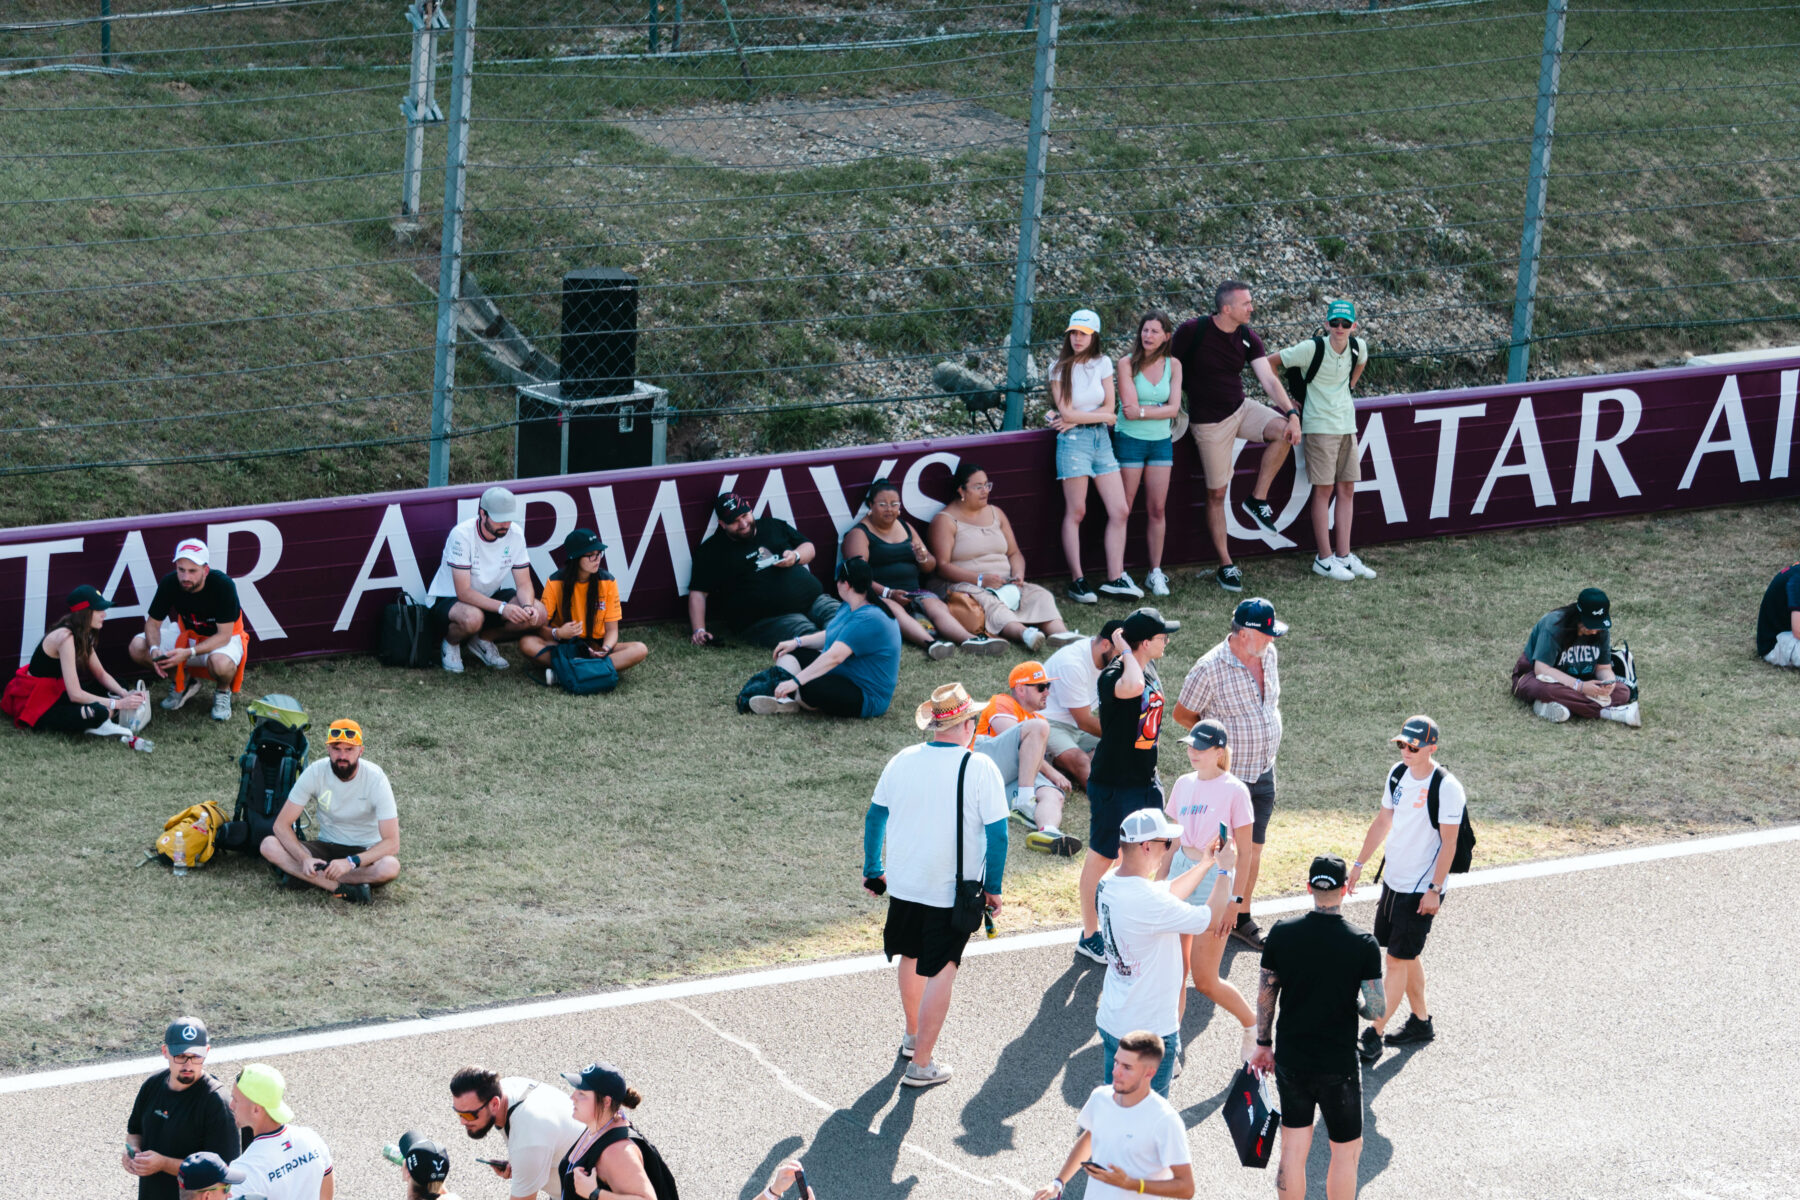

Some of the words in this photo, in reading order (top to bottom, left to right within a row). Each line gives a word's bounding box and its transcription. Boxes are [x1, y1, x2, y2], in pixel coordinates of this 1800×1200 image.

[1224, 388, 1642, 550] QATAR
[1677, 369, 1800, 490] AI
[0, 519, 288, 668] TAR
[333, 452, 961, 632] ARWYS
[268, 1149, 320, 1182] PETRONAS
[1261, 1115, 1271, 1136] Store
